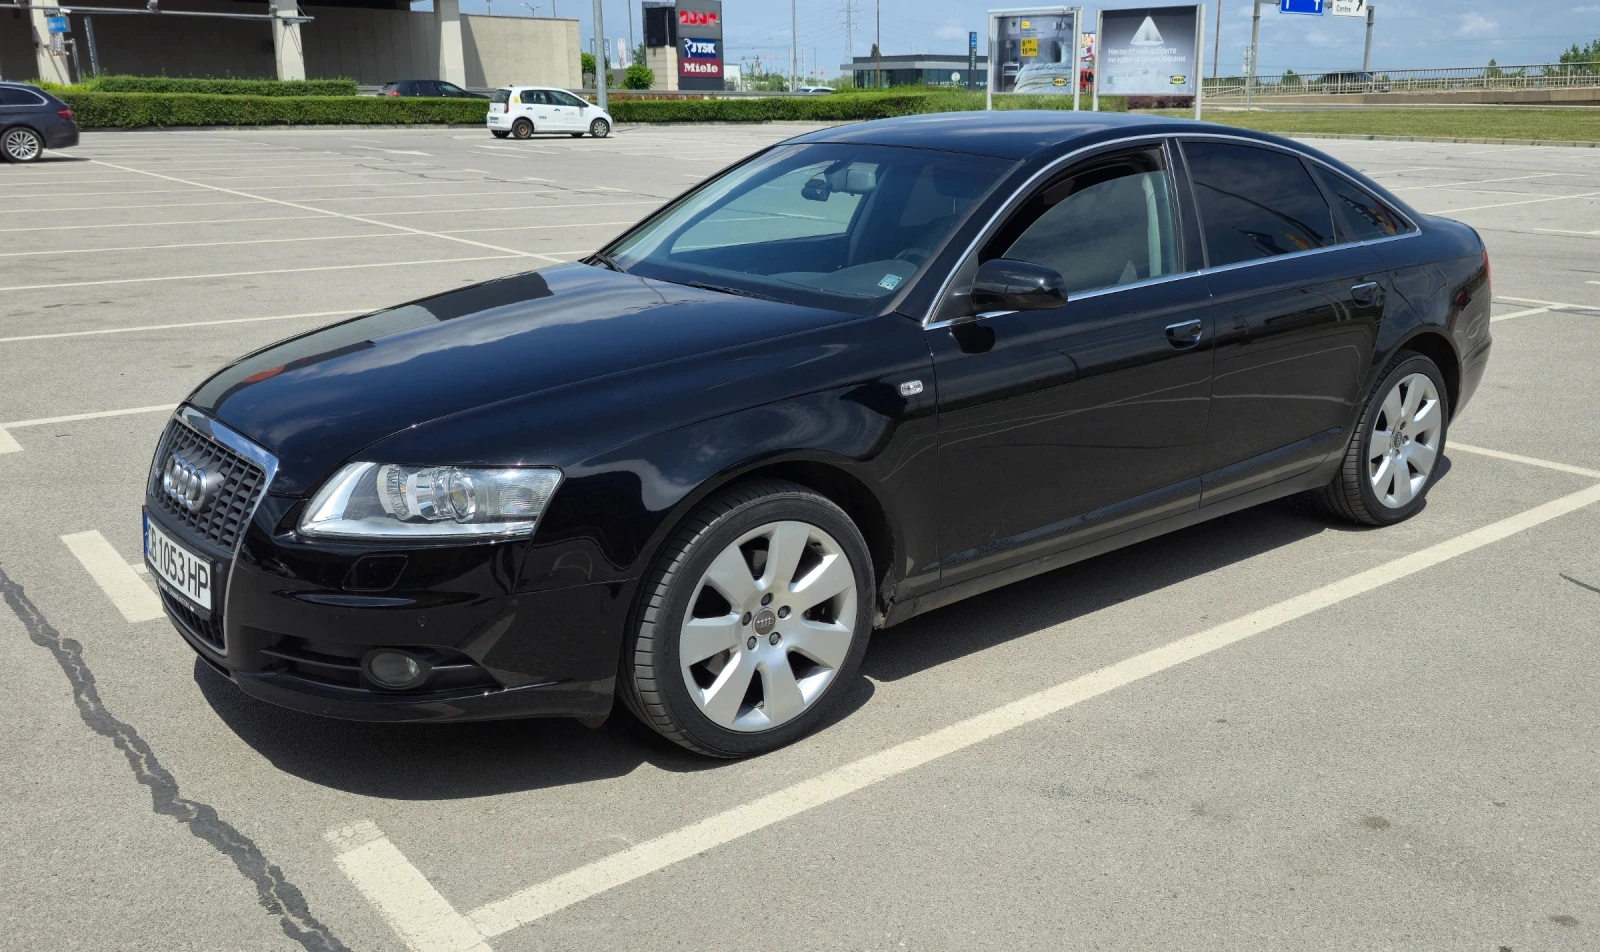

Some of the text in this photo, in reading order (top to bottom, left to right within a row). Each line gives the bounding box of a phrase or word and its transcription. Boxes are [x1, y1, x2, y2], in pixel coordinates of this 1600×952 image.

[691, 42, 716, 54] JYSK
[684, 63, 718, 73] Miele
[159, 536, 186, 587] 1053
[188, 556, 209, 599] HP
